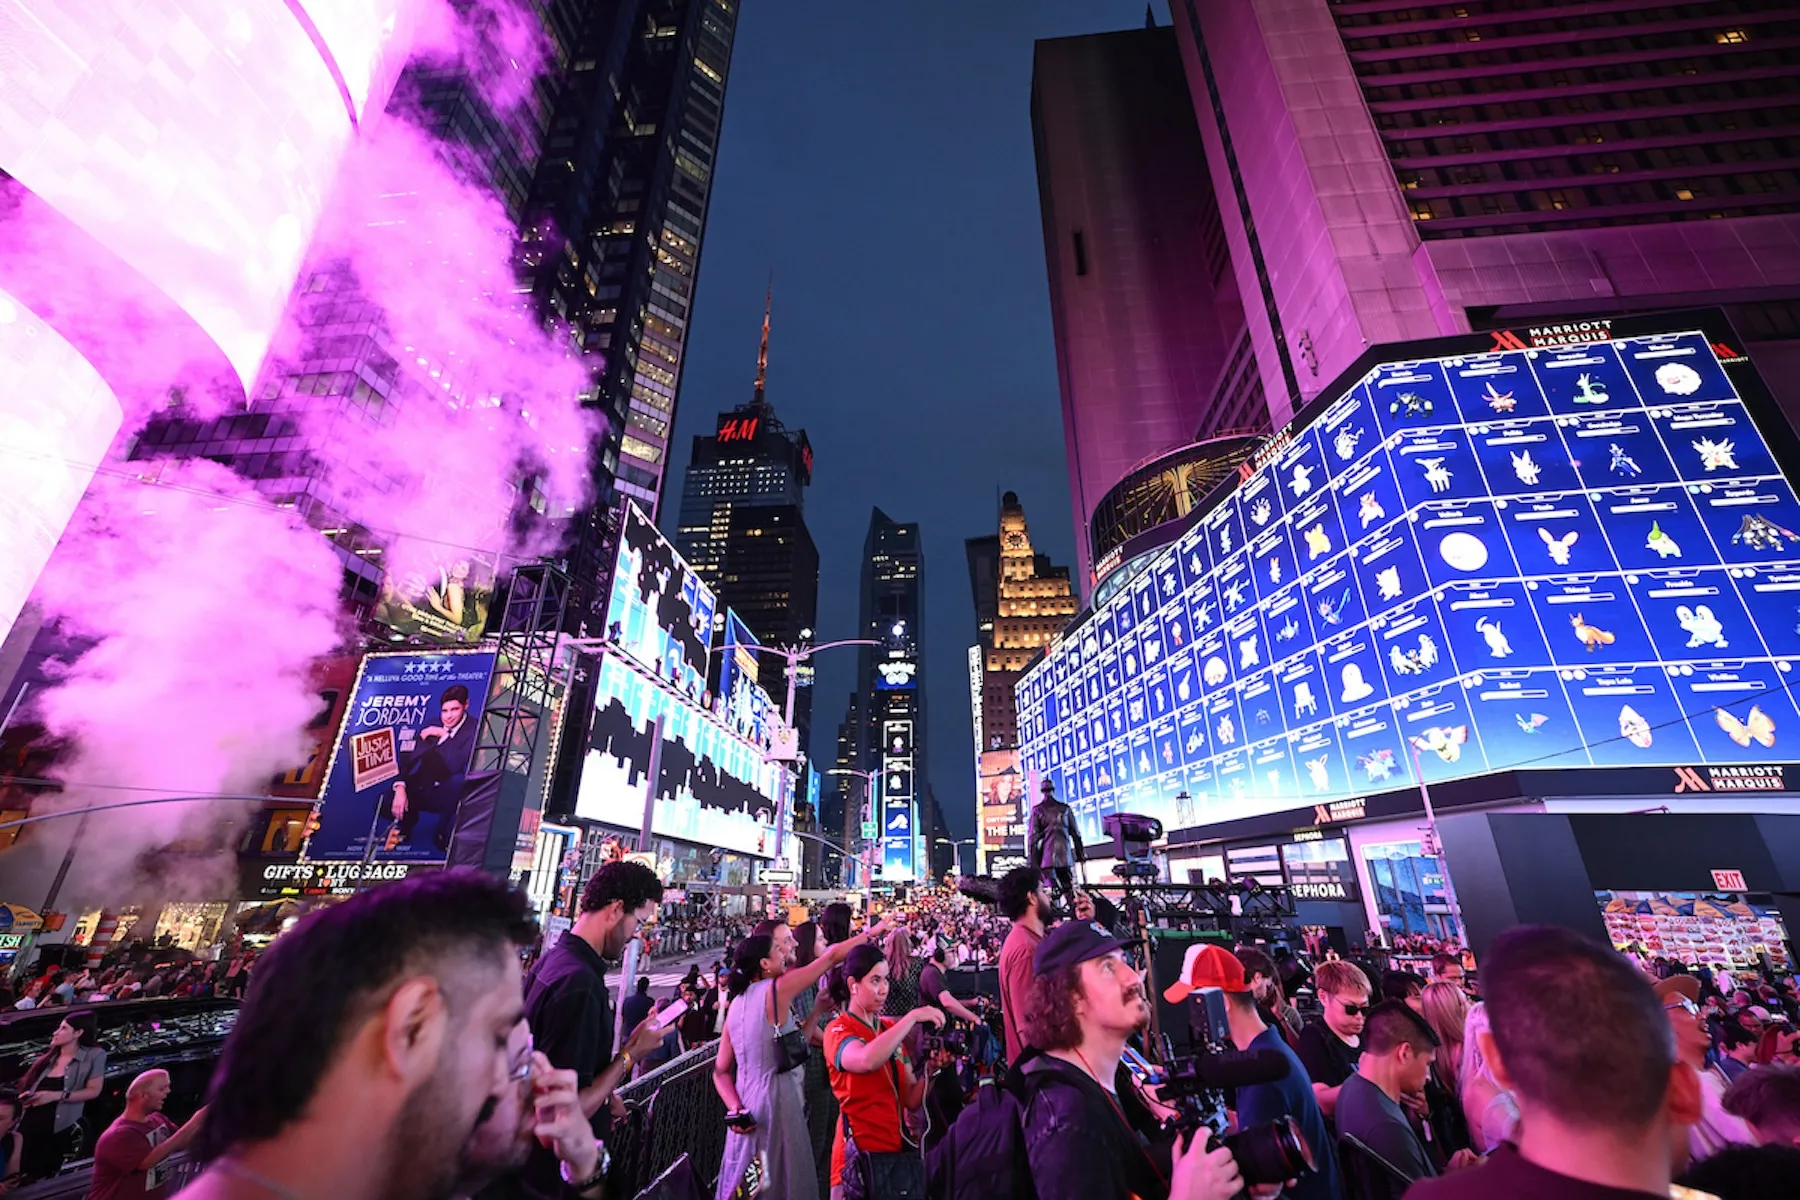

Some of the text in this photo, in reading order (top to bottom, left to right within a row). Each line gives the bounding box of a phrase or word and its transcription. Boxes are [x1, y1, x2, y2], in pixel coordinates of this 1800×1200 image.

[1529, 320, 1612, 337] MARRIOTT
[1533, 331, 1608, 347] MARQUIS
[718, 417, 758, 442] H&M
[401, 673, 424, 682] GOOD
[361, 695, 432, 708] JEREMY
[355, 707, 427, 726] JORDAN
[357, 736, 383, 757] JUST
[357, 748, 393, 769] TIME
[1708, 766, 1784, 778] MARRIOTT
[1713, 777, 1782, 789] MARQUIS
[1329, 798, 1366, 811] MARRIOTT
[986, 825, 1008, 837] THE
[263, 865, 408, 880] GIFTS LUGGAGE
[1714, 872, 1743, 888] EXIT
[330, 887, 356, 895] SONY
[1291, 882, 1346, 898] SEPHORA
